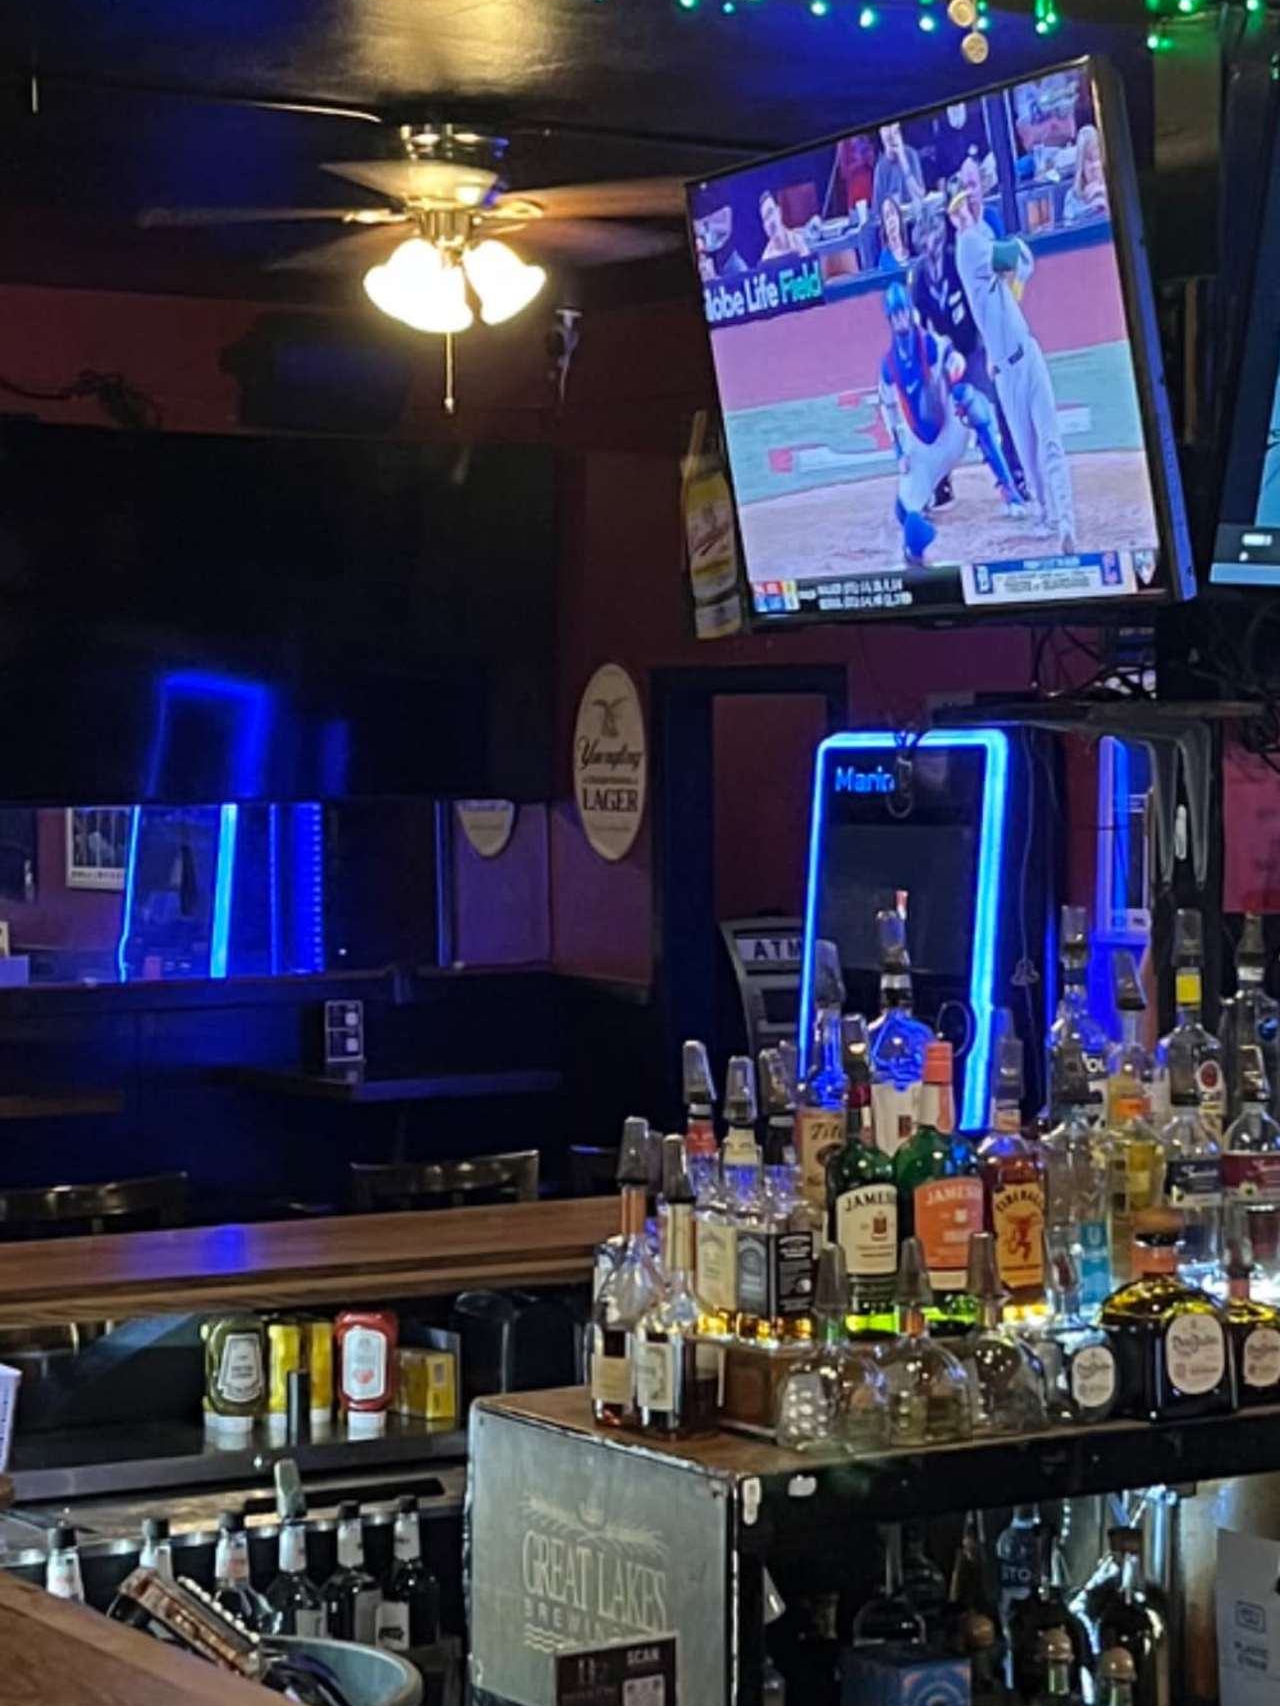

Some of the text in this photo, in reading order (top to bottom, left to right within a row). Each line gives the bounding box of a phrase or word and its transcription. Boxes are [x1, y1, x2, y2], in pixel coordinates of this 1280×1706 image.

[744, 274, 779, 313] Life
[778, 261, 822, 305] Field
[582, 788, 639, 813] LAGER
[522, 1530, 668, 1633] GREAT LAKES
[626, 1647, 660, 1666] SCAN
